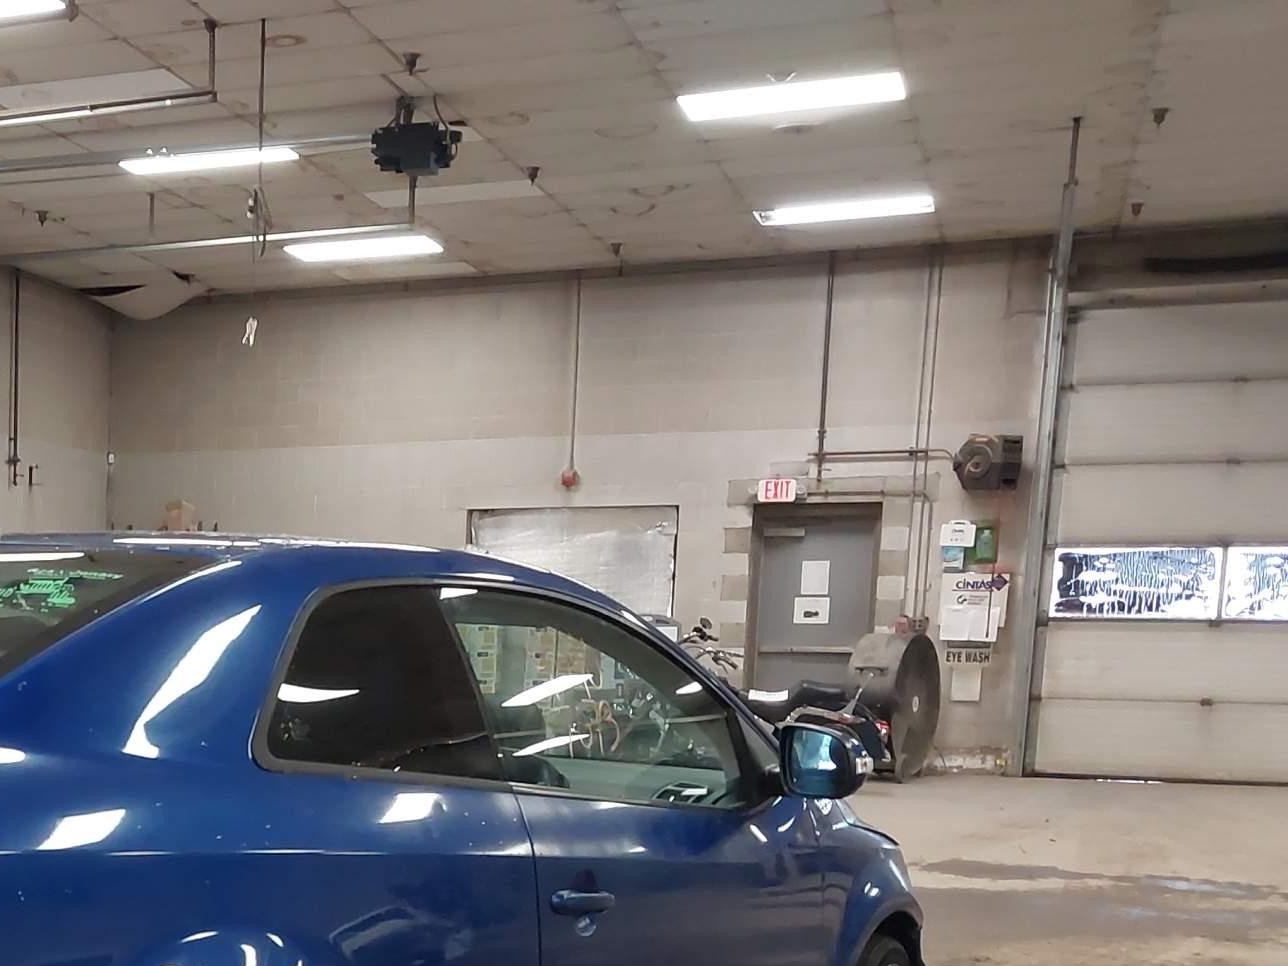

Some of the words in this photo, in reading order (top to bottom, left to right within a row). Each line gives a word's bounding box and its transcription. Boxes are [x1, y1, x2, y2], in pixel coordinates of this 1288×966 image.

[765, 480, 791, 499] EXIT
[946, 652, 962, 663] EYE
[965, 651, 990, 663] WASH
